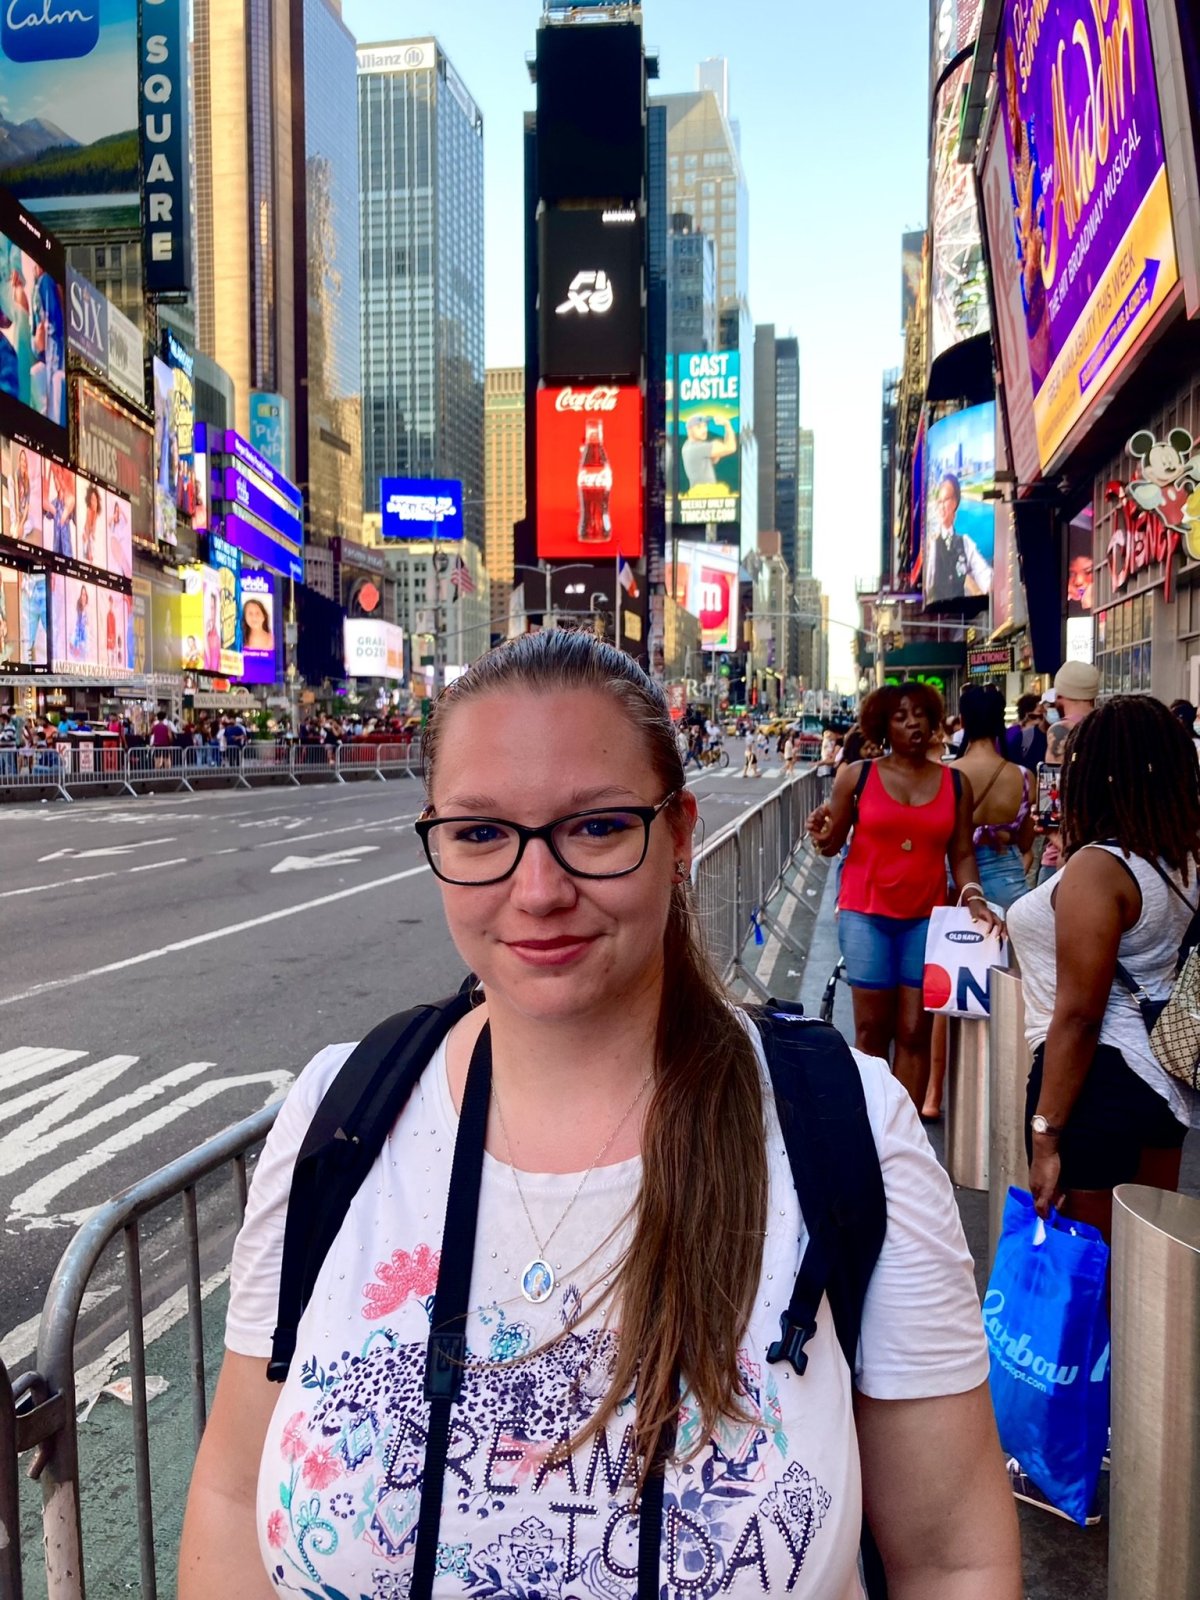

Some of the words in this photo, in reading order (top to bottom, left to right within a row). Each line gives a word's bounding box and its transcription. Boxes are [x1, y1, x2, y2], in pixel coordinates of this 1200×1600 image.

[6, 0, 95, 31] Calm
[143, 35, 174, 261] SQUARE
[1067, 191, 1105, 285] BROADWAY
[1103, 118, 1141, 210] MUSICAL
[1110, 241, 1136, 302] WEEK
[680, 377, 738, 400] CASTLE
[690, 354, 729, 377] CAST
[556, 384, 619, 411] Coca-Cola
[949, 932, 962, 940] OLD
[962, 933, 980, 941] NAVY
[382, 1414, 645, 1499] DREAM
[548, 1500, 815, 1595] TODAY
